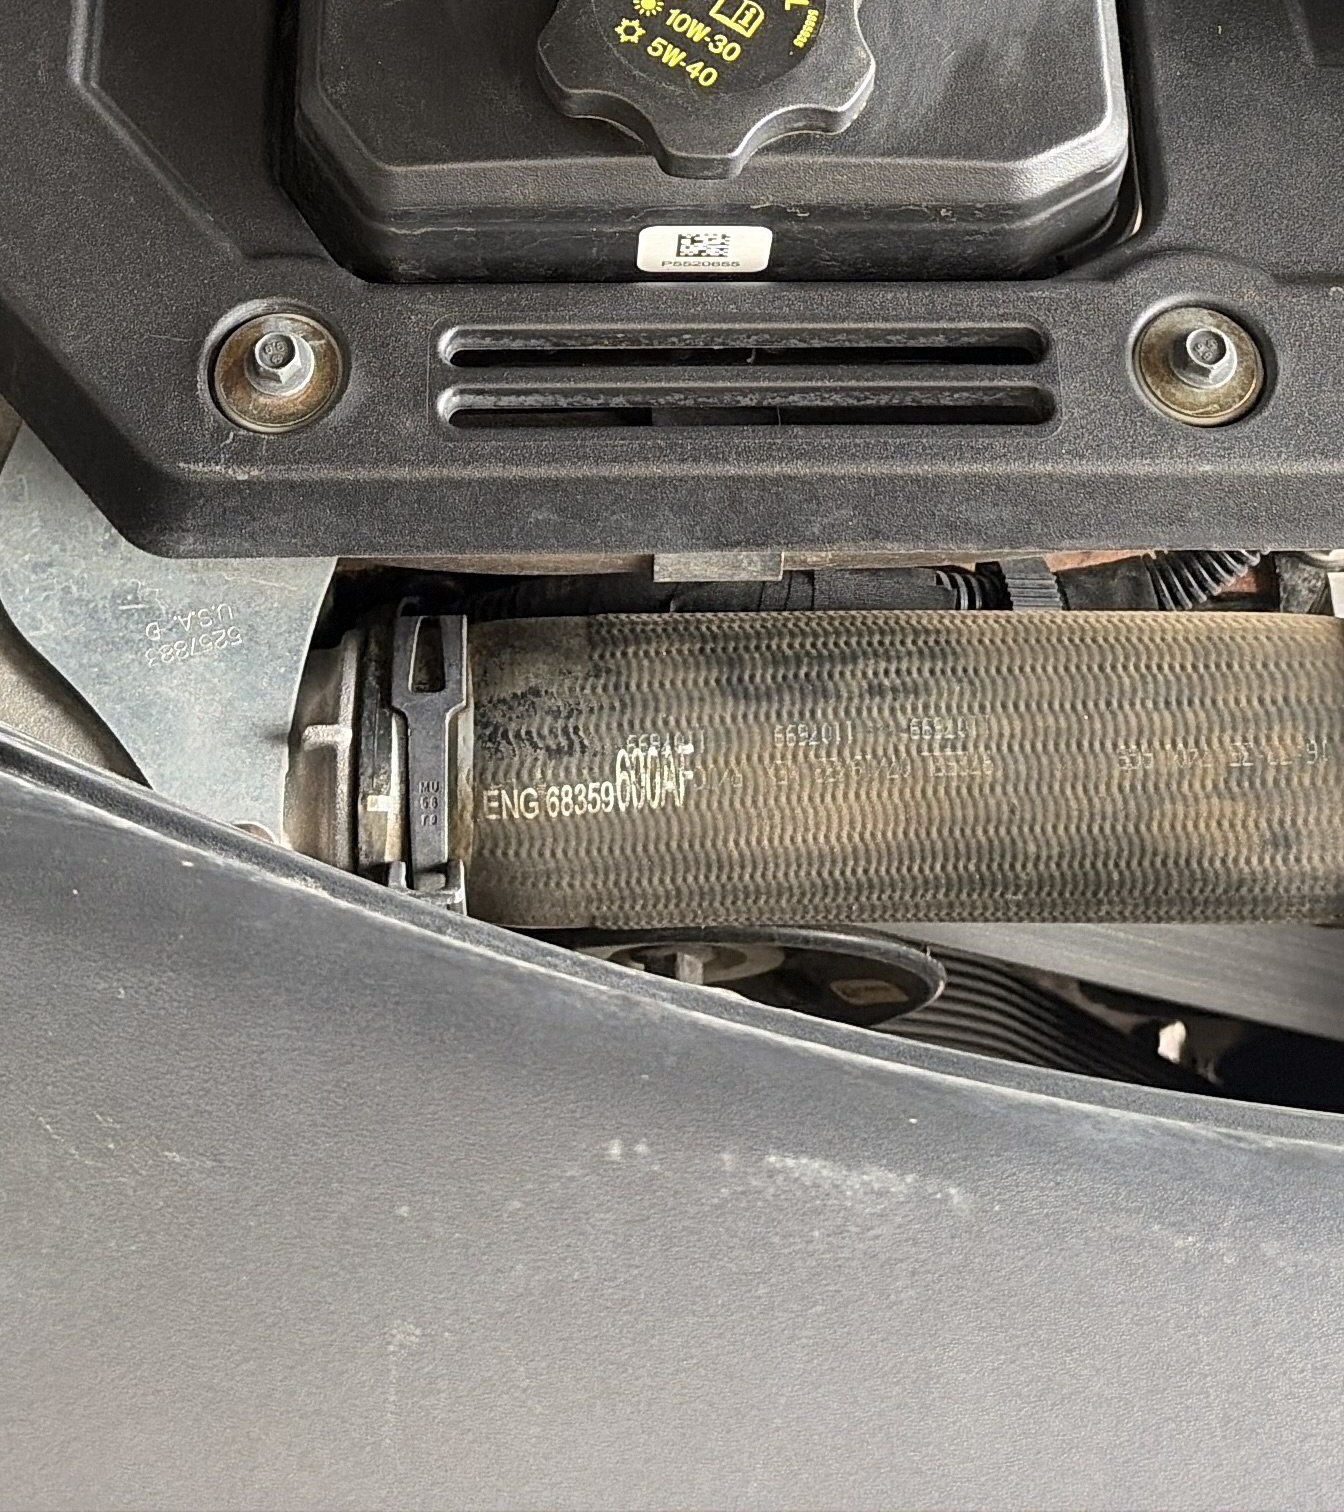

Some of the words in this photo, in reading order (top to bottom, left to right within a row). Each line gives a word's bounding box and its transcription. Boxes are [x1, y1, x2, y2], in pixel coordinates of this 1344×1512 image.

[645, 35, 719, 88] 5W-40
[663, 8, 742, 63] 10W-30
[482, 783, 541, 821] ENG
